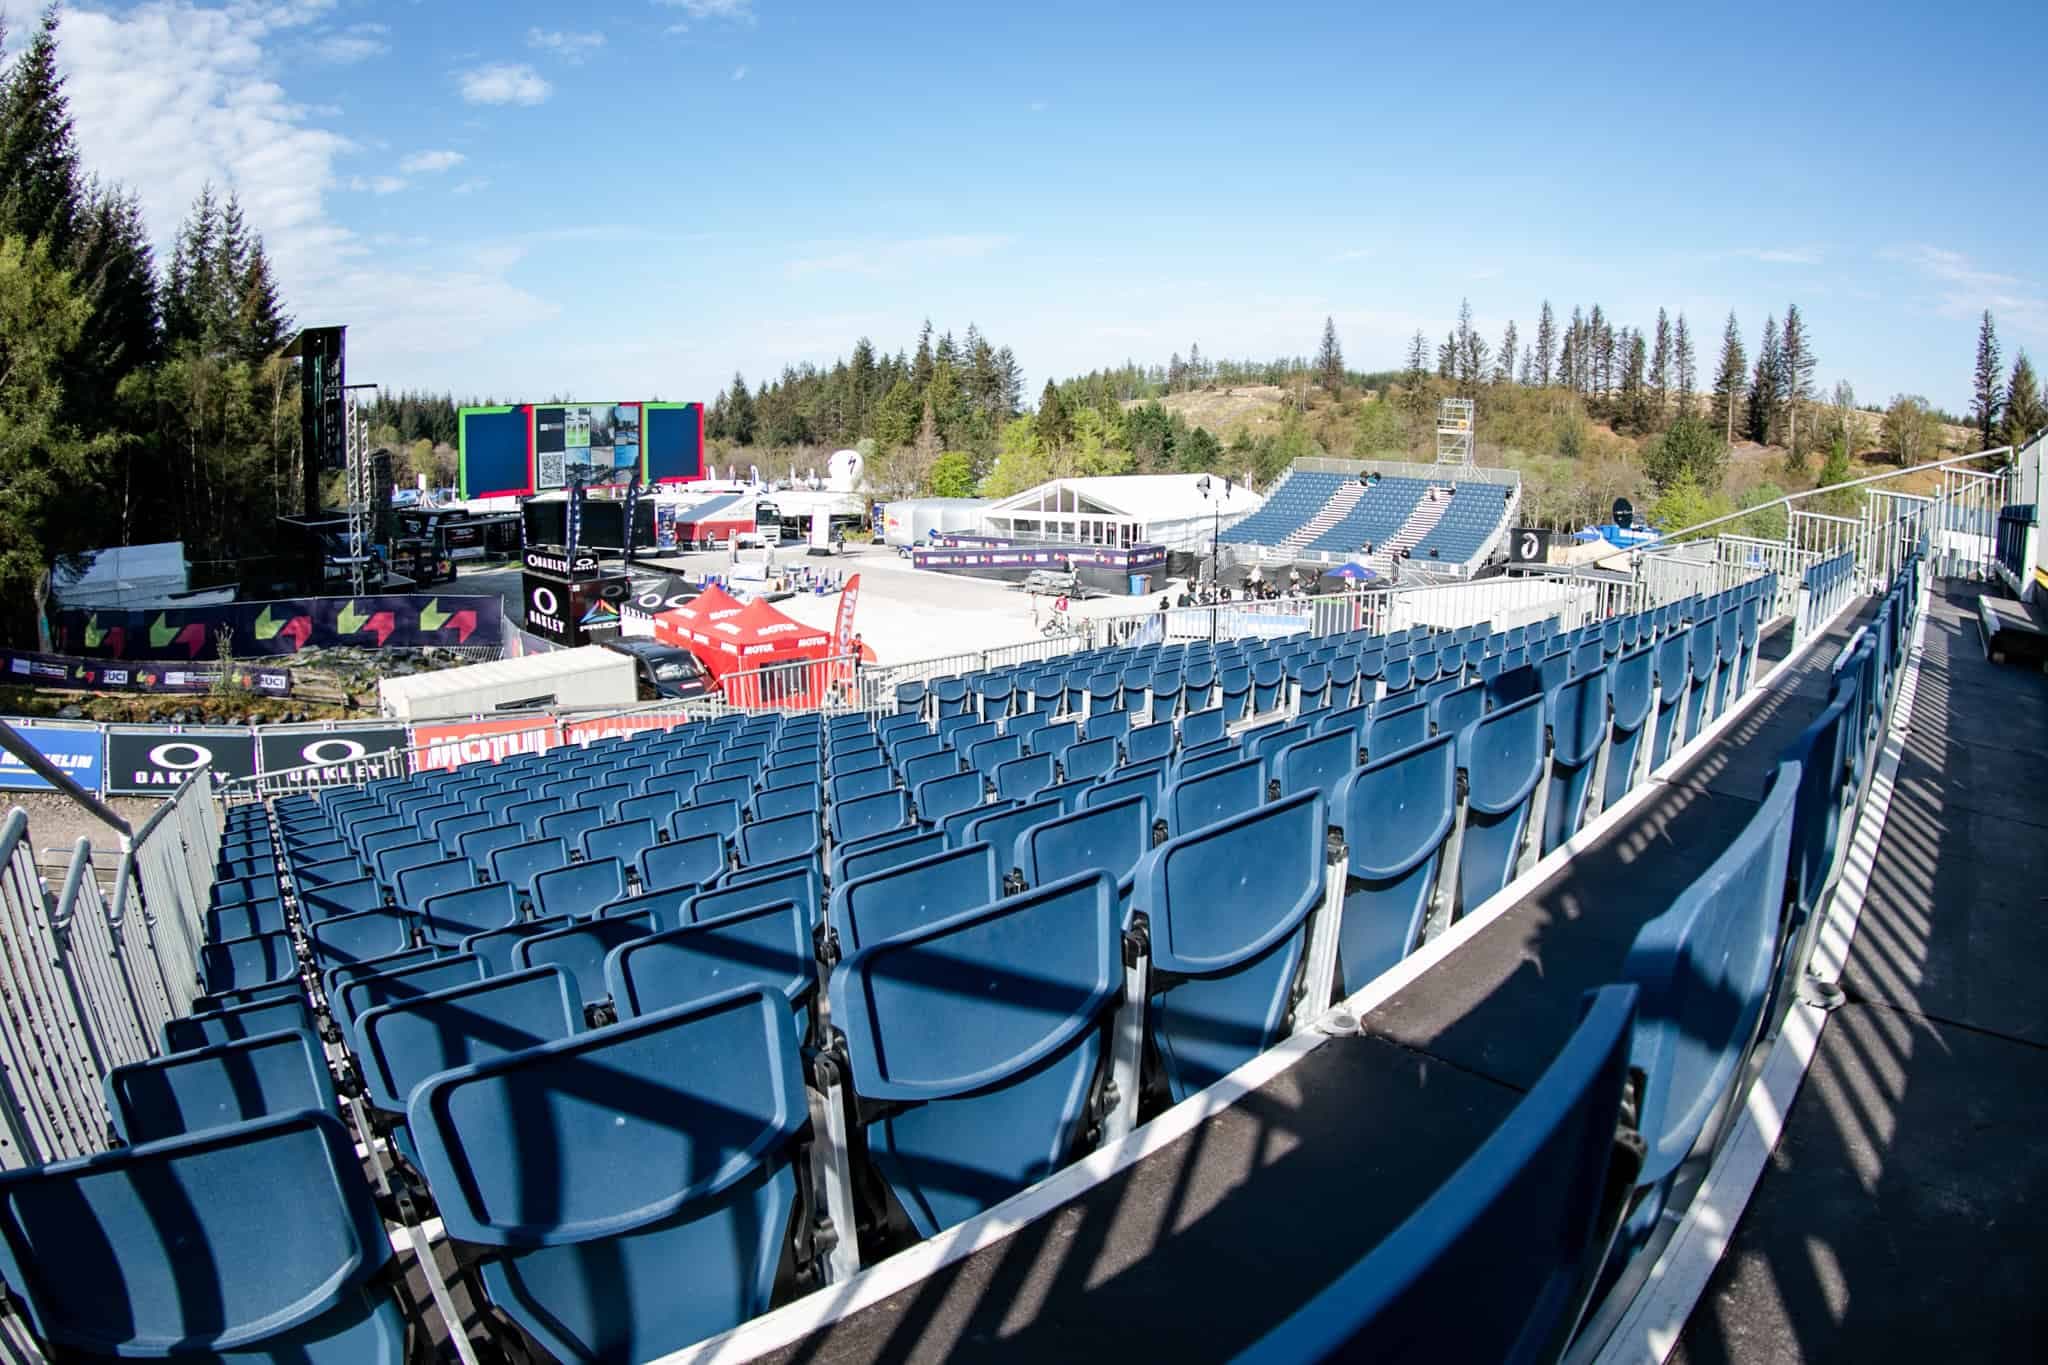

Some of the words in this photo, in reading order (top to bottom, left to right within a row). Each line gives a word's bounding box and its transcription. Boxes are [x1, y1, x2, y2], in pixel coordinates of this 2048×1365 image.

[529, 610, 566, 633] OAKLEY
[798, 636, 828, 648] MOTUL
[743, 643, 775, 655] MOTUL
[108, 671, 127, 682] UCI
[265, 676, 284, 687] UCI
[426, 729, 551, 767] MOTUL
